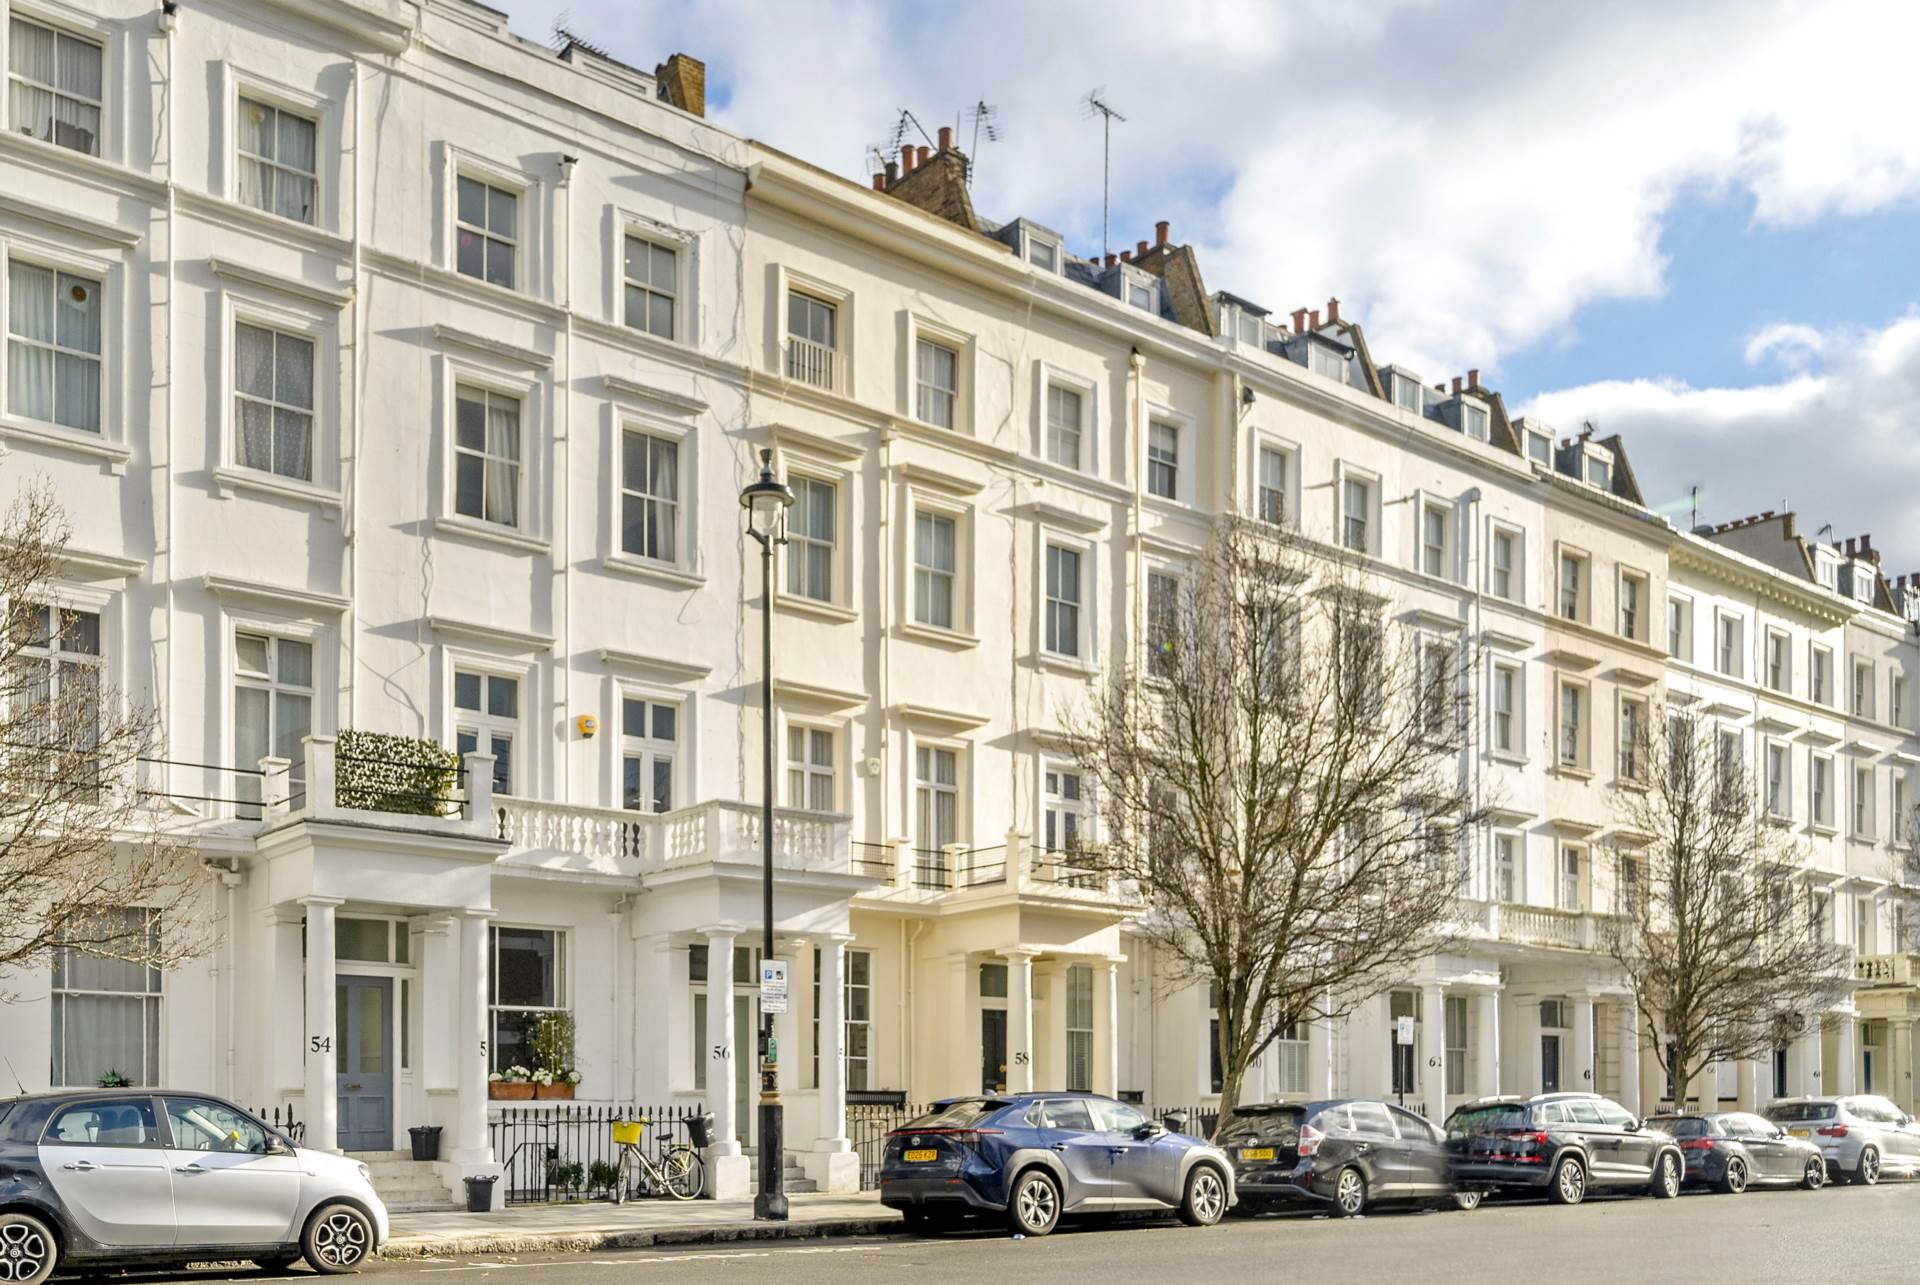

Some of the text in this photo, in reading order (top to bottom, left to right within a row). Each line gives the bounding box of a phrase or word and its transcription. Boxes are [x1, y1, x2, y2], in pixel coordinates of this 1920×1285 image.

[311, 1036, 331, 1053] 54
[713, 1046, 730, 1060] 56
[1015, 1052, 1029, 1065] 58
